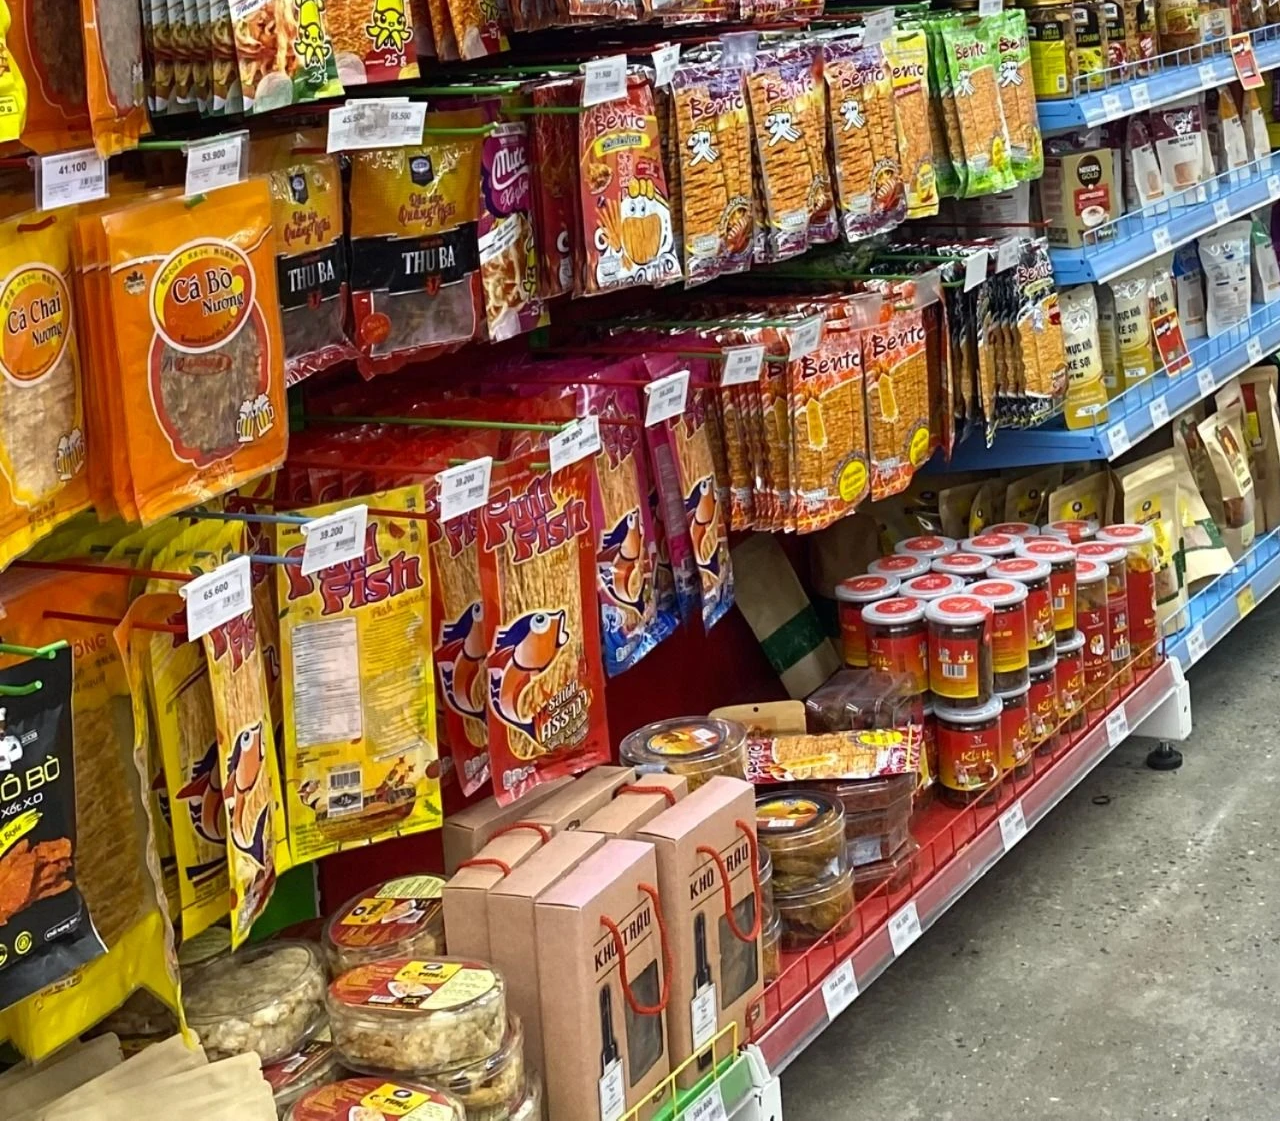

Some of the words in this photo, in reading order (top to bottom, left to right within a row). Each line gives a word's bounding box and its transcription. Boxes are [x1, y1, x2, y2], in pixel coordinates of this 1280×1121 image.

[384, 53, 399, 69] 25
[892, 63, 925, 79] ento
[690, 94, 745, 120] Bento
[593, 112, 647, 136] Bento
[59, 161, 88, 175] 41.100
[201, 149, 226, 163] 53.900
[402, 250, 435, 276] THU
[438, 245, 457, 269] BA
[172, 273, 202, 304] Cá
[206, 266, 233, 295] Bò
[287, 264, 316, 293] THU
[317, 259, 336, 284] BA
[8, 305, 27, 335] Cá
[30, 290, 62, 326] Chai
[871, 325, 926, 357] Bento
[801, 350, 862, 378] Bento
[513, 496, 589, 564] Fish
[203, 581, 229, 600] 65.600
[320, 551, 423, 616] Fish
[26, 755, 60, 791] BÒ
[723, 843, 749, 873] RAU
